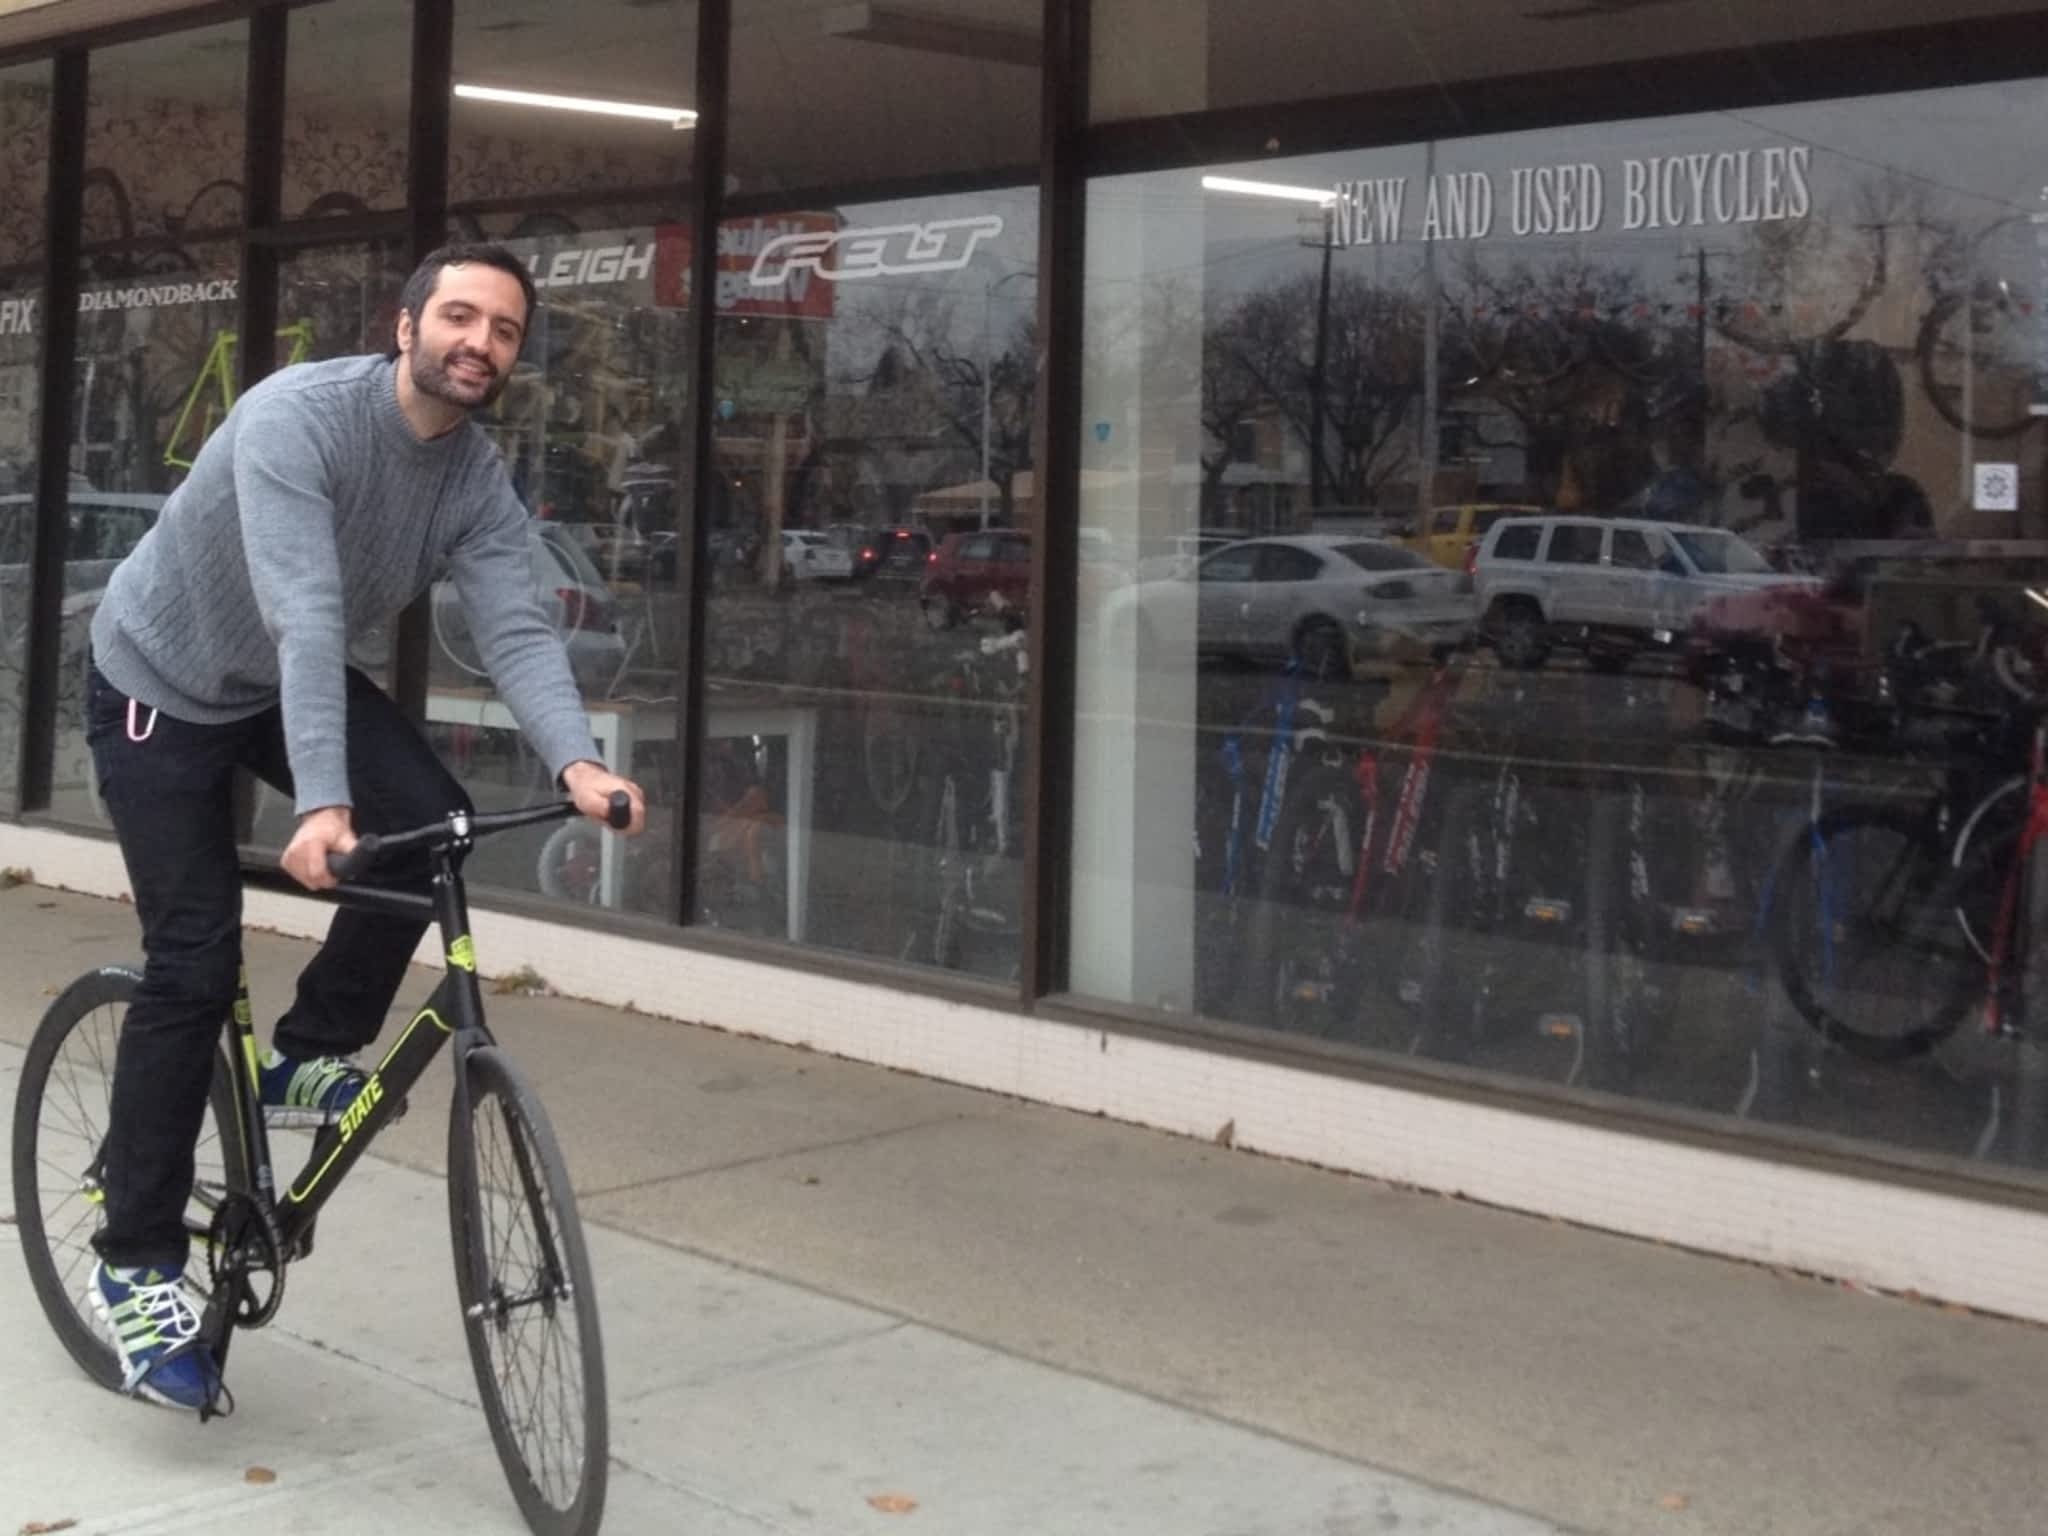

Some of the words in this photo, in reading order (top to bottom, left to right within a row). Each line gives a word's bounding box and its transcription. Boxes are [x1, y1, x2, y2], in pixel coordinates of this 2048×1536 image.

[1330, 177, 1407, 247] NEW
[1421, 171, 1493, 241] AND
[1511, 162, 1603, 237] USED
[1622, 146, 1812, 231] BICYCLES
[78, 279, 239, 312] DIAMONDBACK
[340, 1072, 384, 1144] STATE
